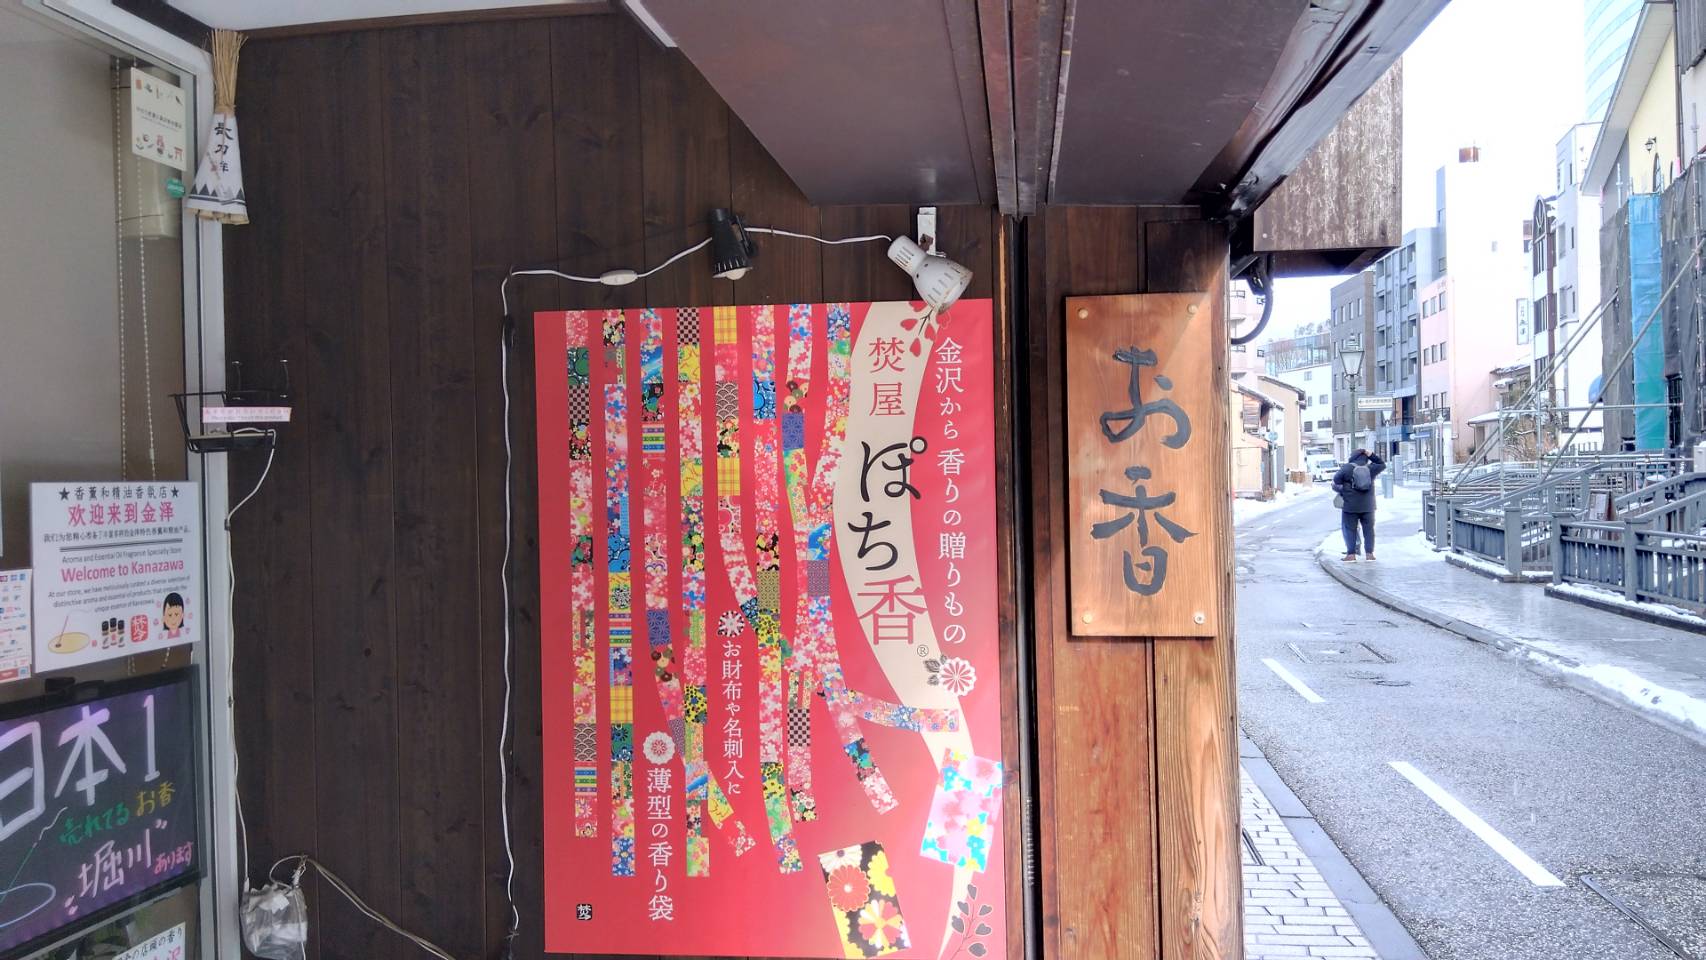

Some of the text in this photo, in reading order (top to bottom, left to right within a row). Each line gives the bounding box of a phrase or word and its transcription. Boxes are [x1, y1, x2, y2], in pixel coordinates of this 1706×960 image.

[67, 501, 175, 527] 欢迎来到金泽
[1090, 345, 1199, 596] お香
[61, 559, 184, 582] Welcome to Kanazawa
[722, 640, 745, 795] お財布や名刺入に
[647, 767, 674, 921] 薄型の香り袋
